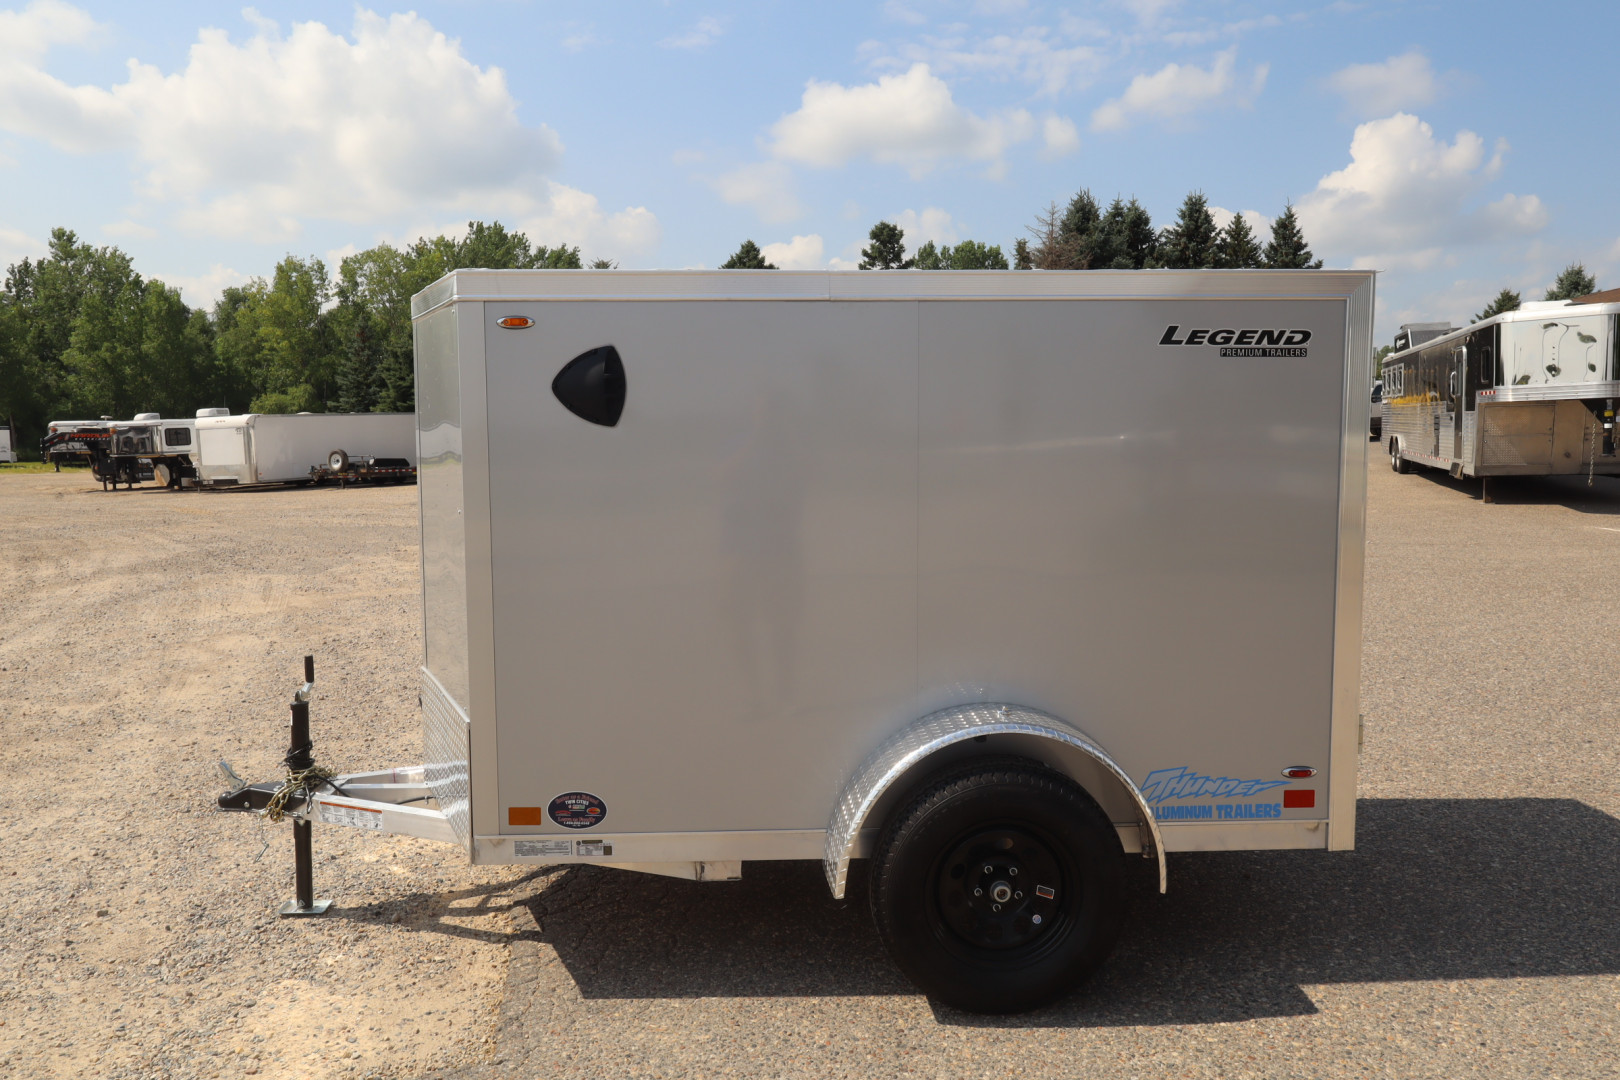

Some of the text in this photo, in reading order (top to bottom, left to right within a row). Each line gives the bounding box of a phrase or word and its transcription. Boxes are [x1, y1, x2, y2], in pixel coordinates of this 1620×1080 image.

[1158, 325, 1312, 346] LEGEND
[1221, 349, 1307, 357] PREMIUM TRAILERS
[1215, 803, 1282, 819] TRAILERS
